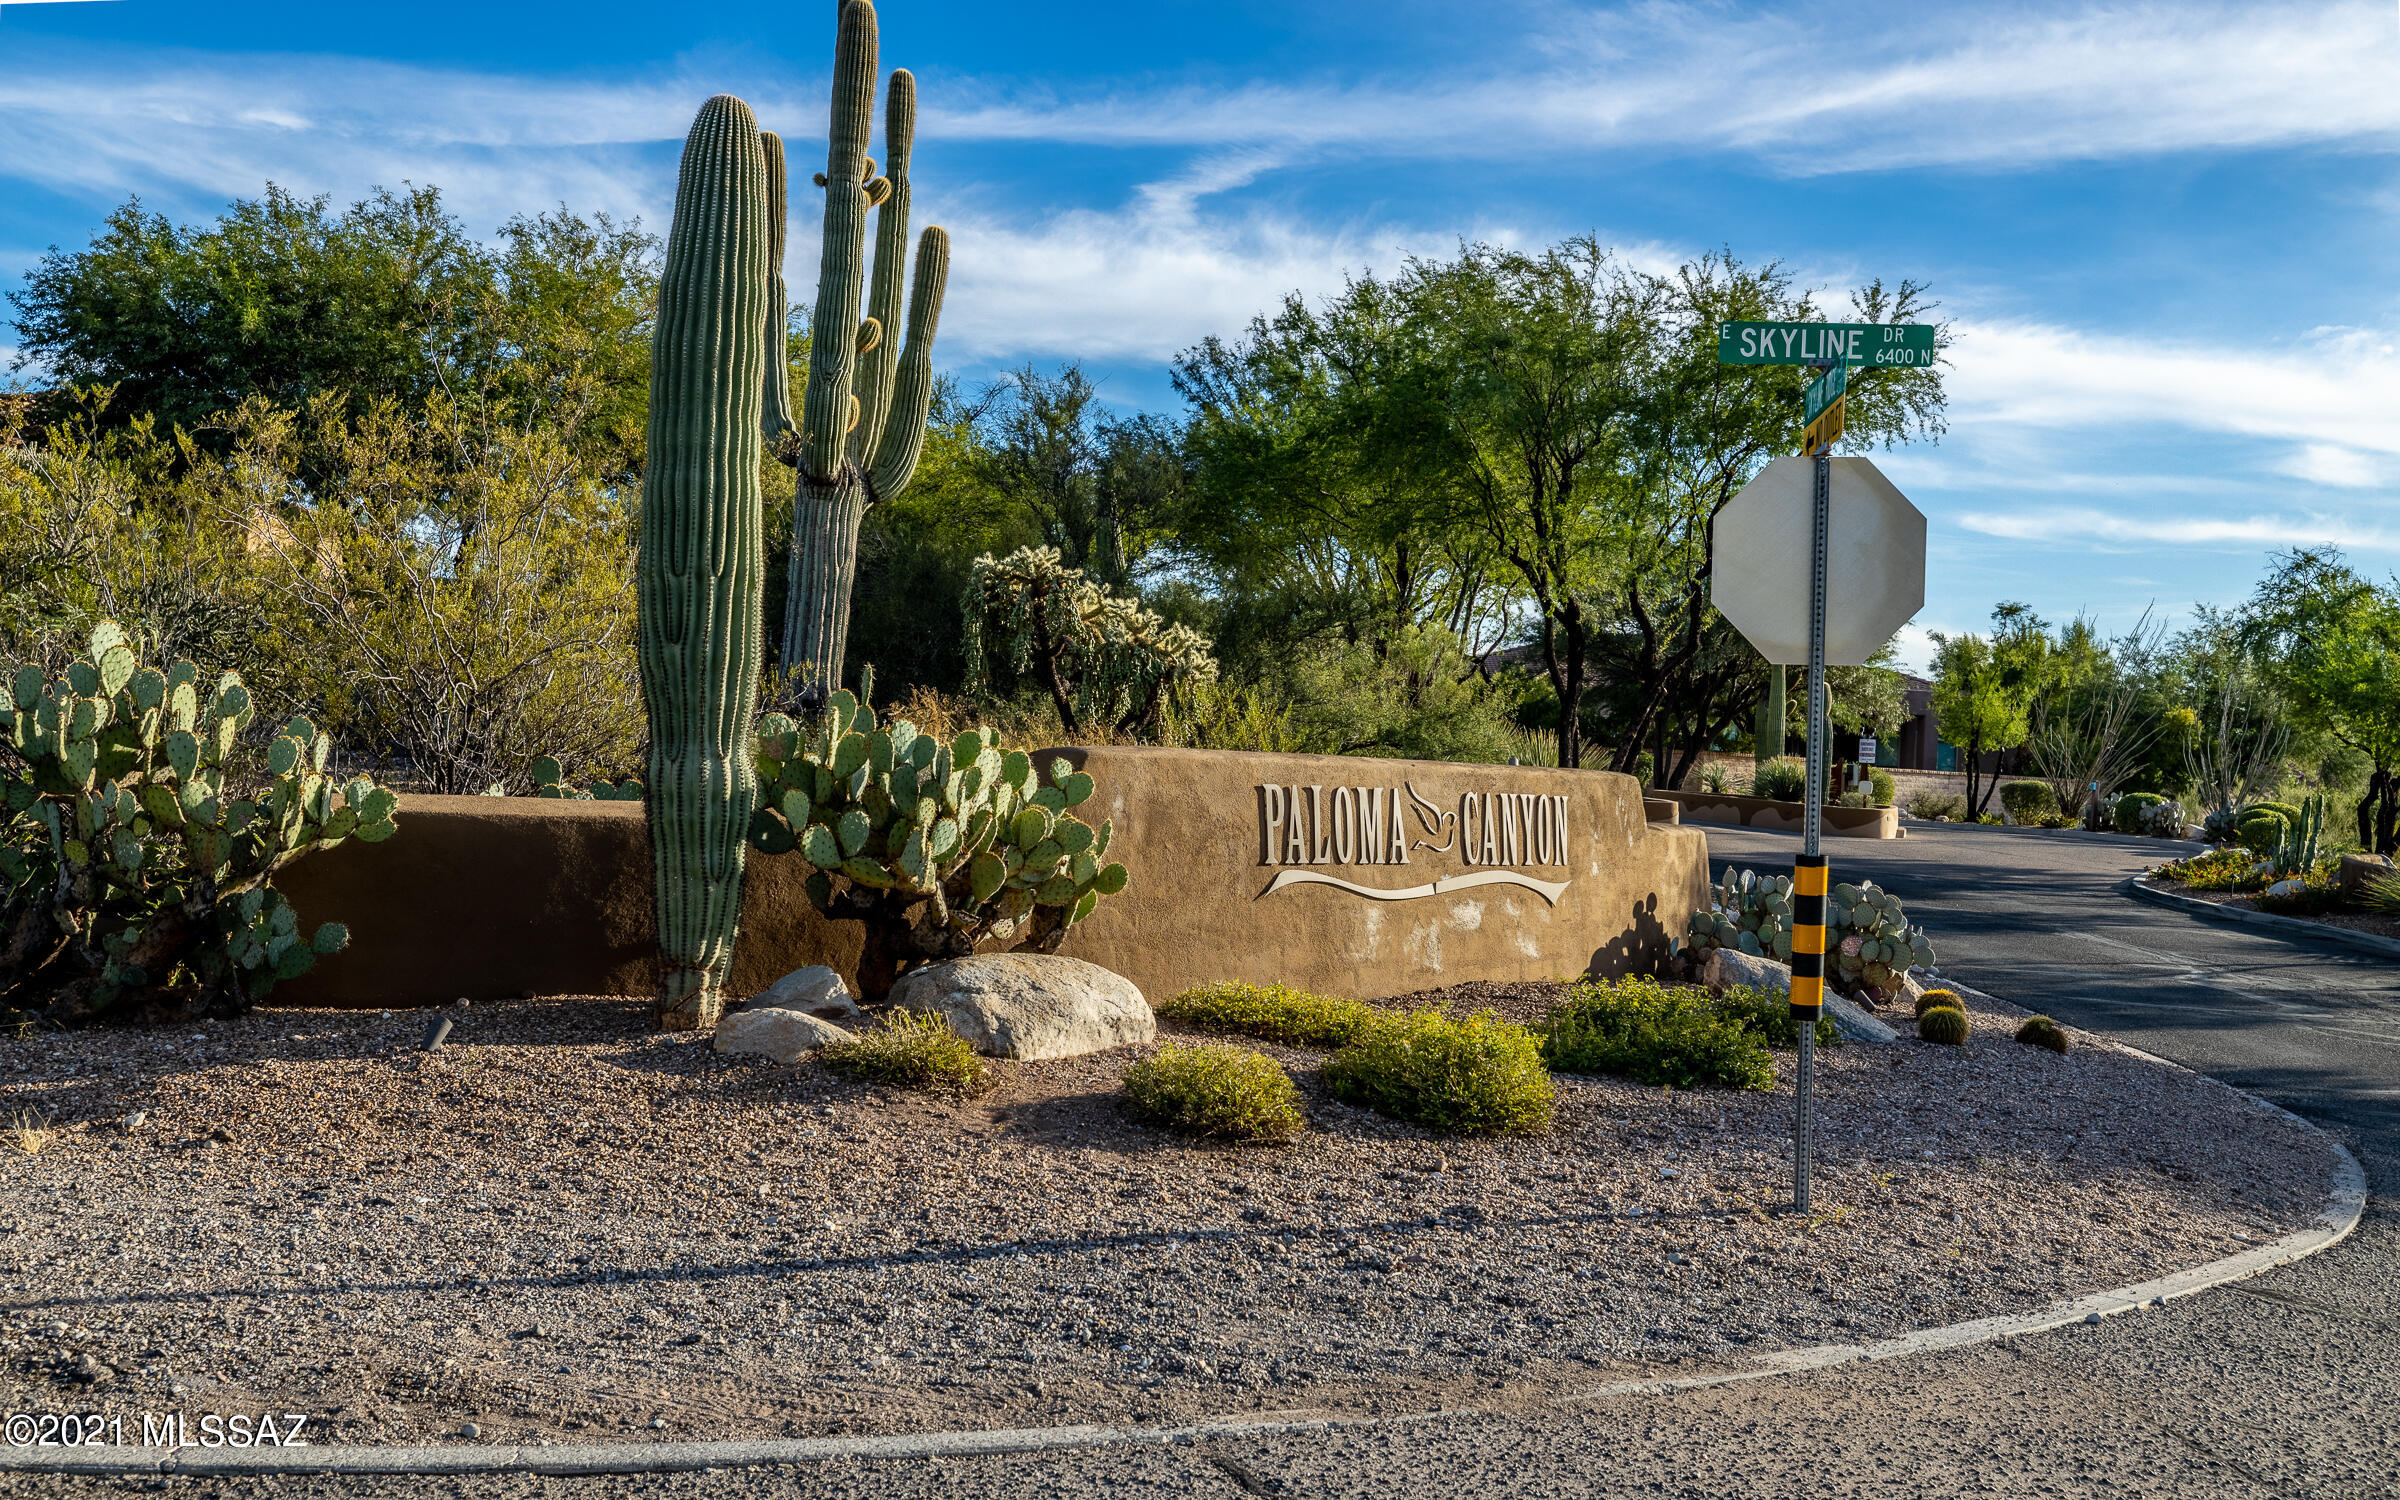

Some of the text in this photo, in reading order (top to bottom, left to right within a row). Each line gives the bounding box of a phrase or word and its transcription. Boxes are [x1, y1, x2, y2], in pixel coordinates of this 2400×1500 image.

[1722, 324, 1904, 360] E SKYLINE DR
[1875, 348, 1931, 364] 6400 N
[1261, 783, 1569, 866] PALOMA CANYON
